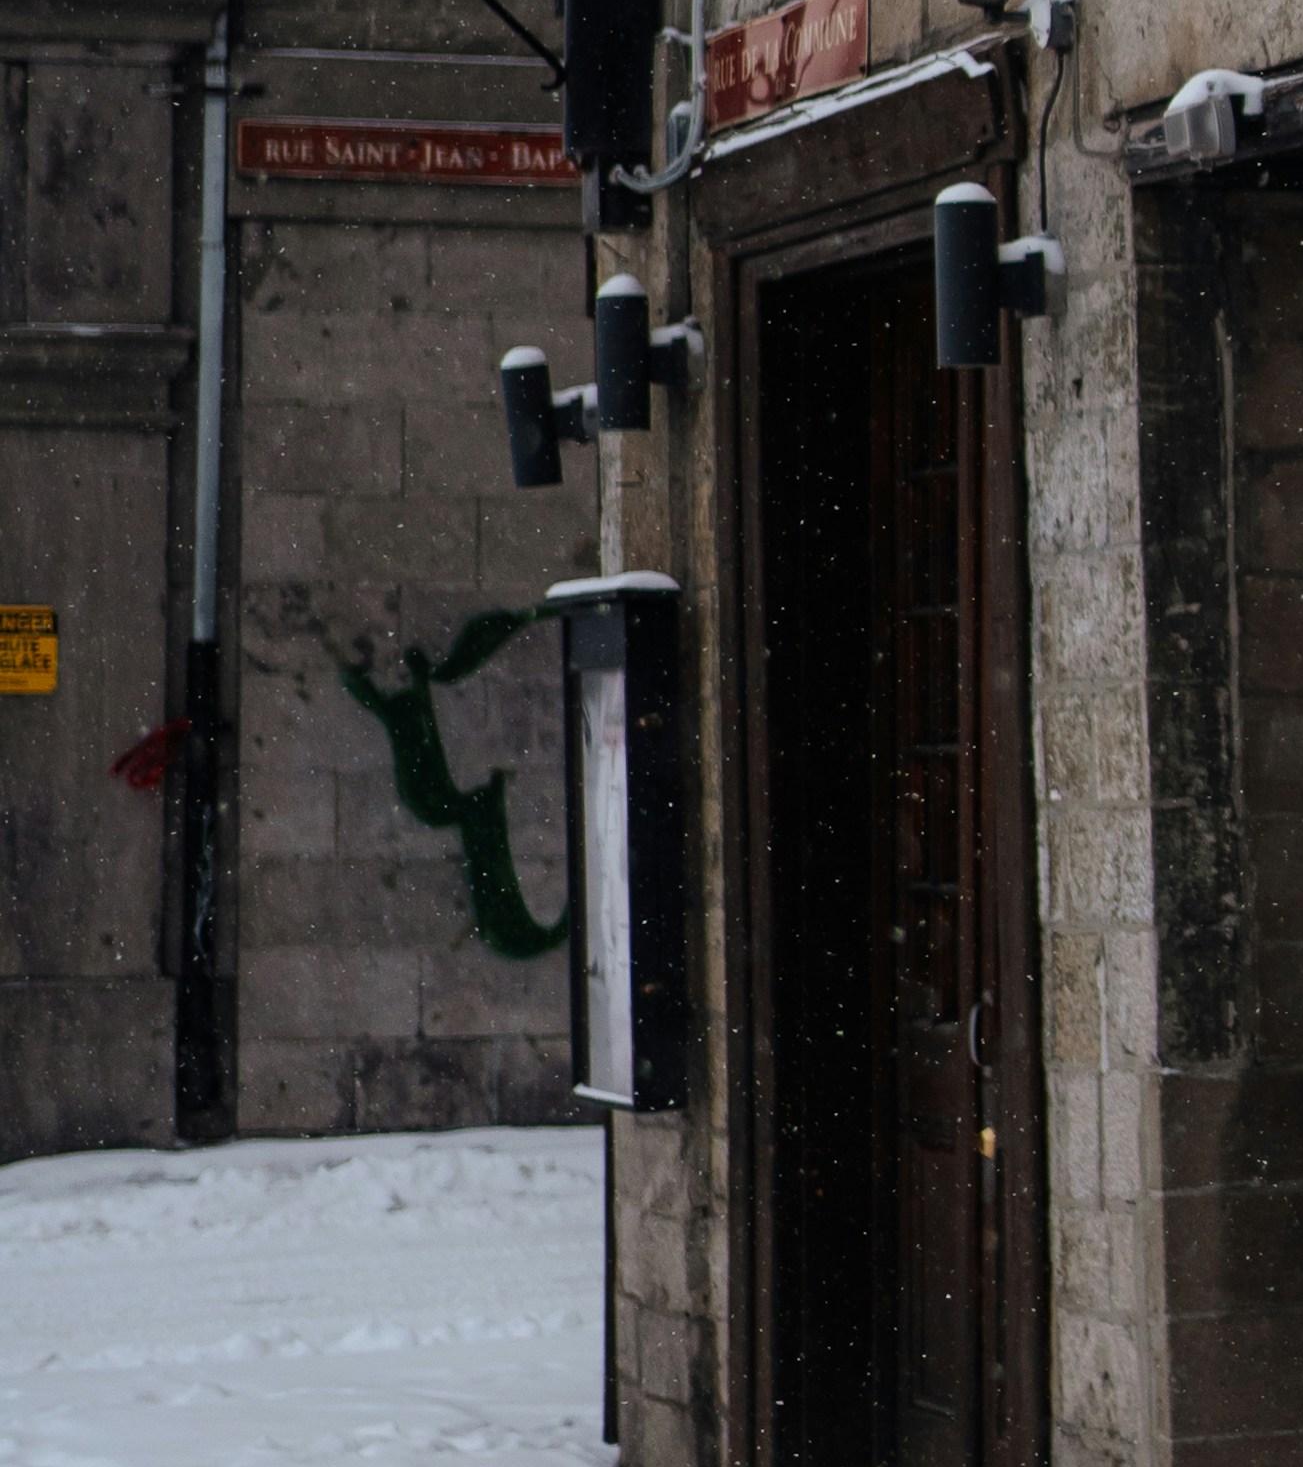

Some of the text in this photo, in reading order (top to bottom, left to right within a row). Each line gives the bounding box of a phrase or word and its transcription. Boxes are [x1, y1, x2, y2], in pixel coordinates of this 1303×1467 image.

[714, 54, 736, 93] RUE
[784, 6, 858, 67] COMMUNE
[265, 138, 314, 163] RUE
